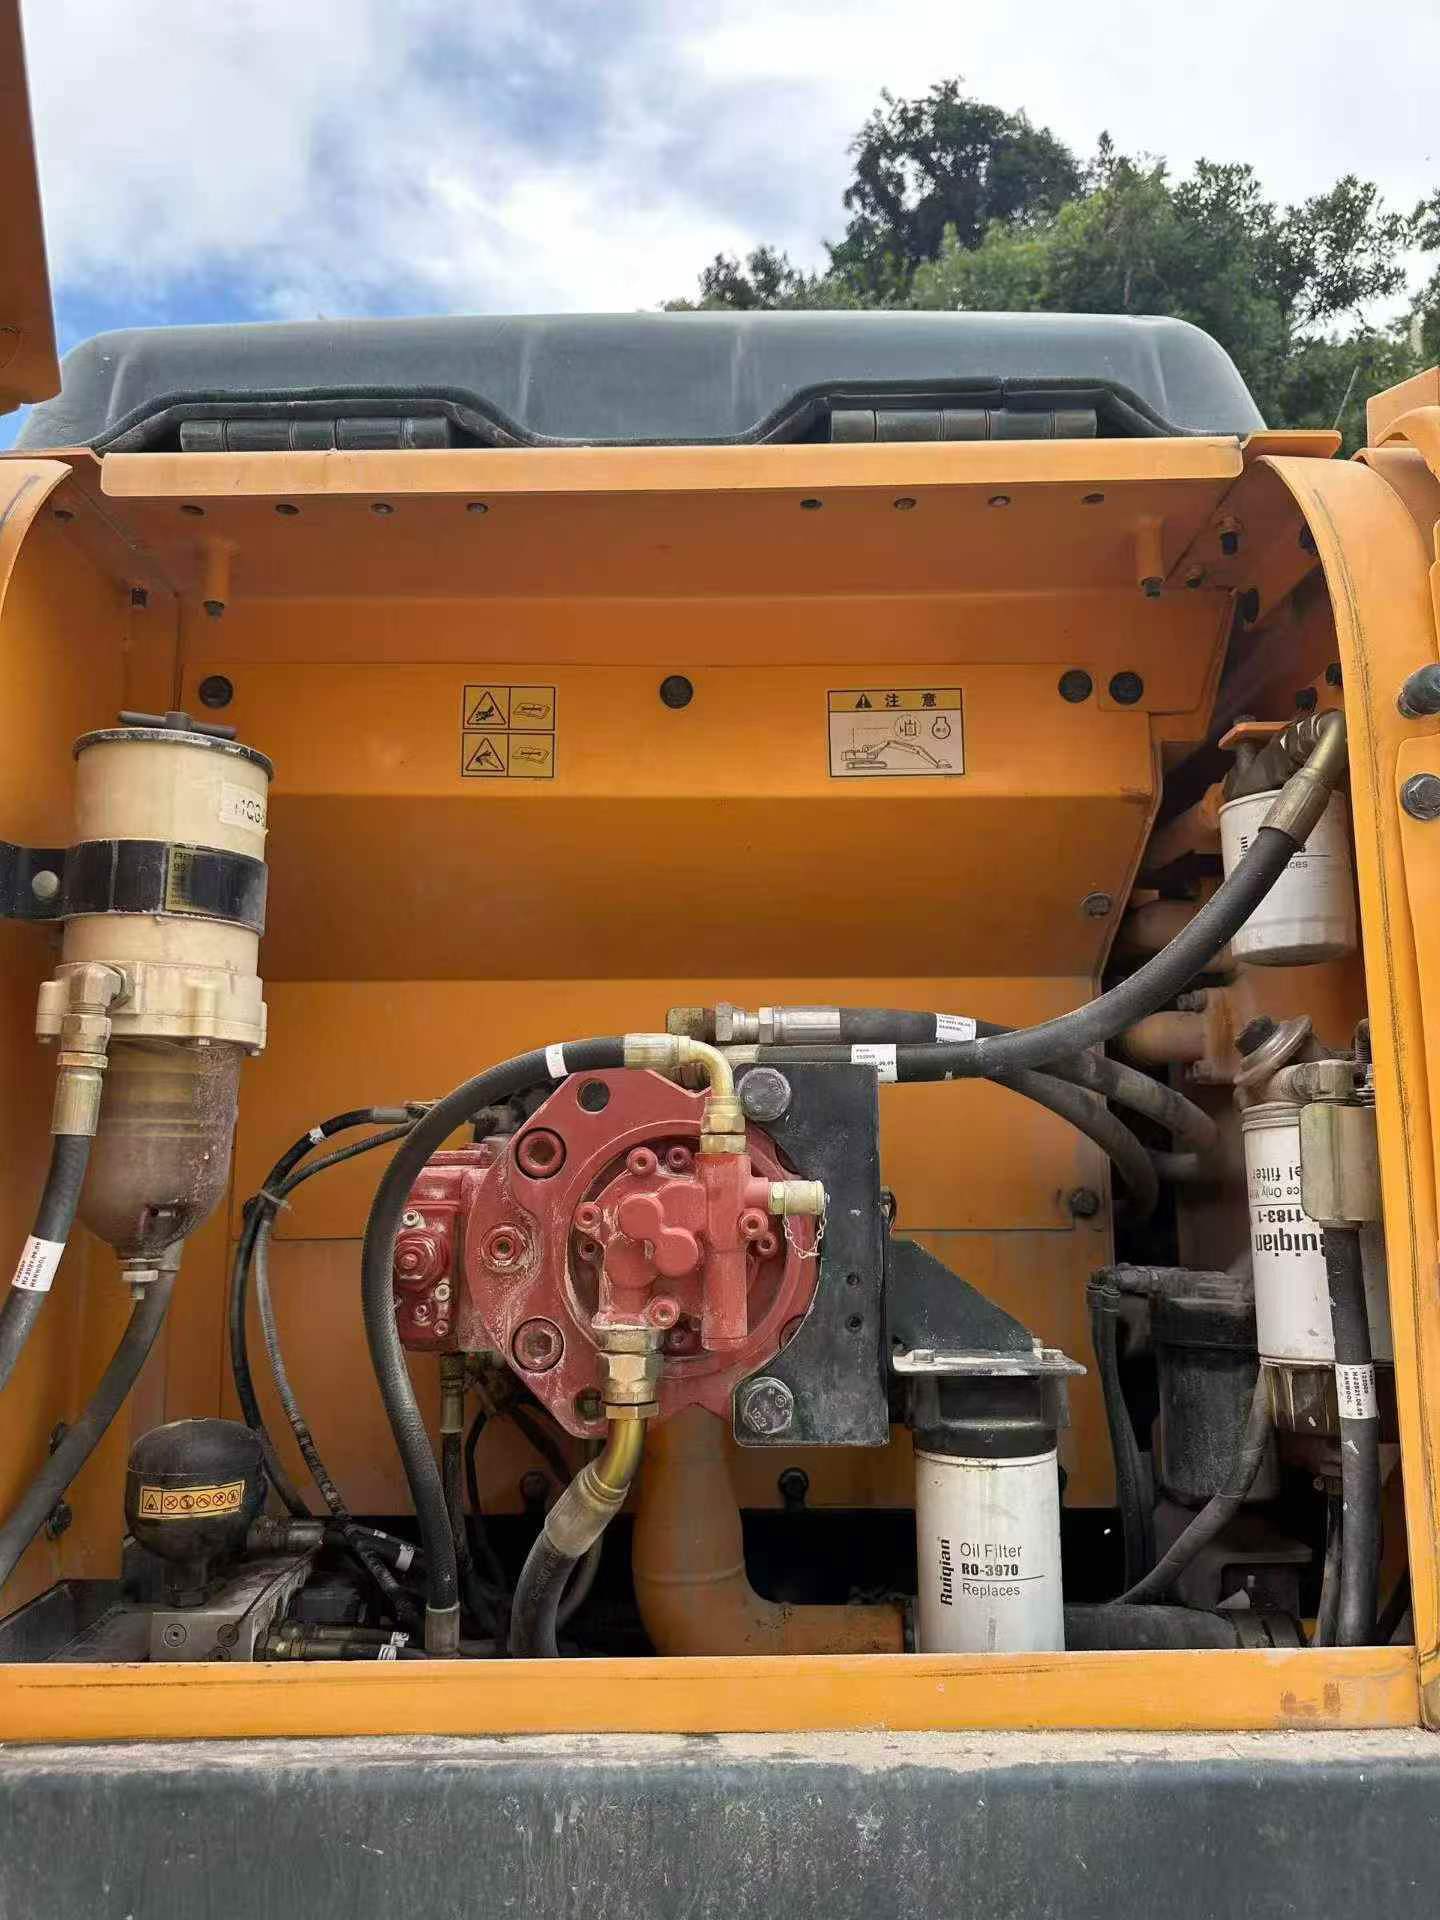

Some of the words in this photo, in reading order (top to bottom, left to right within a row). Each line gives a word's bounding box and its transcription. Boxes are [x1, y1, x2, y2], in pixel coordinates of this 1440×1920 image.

[885, 693, 936, 709] 注意
[960, 1542, 980, 1558] Oil
[984, 1543, 1022, 1559] Filter
[940, 1537, 954, 1607] Ruiqian
[962, 1582, 1021, 1599] Replaces
